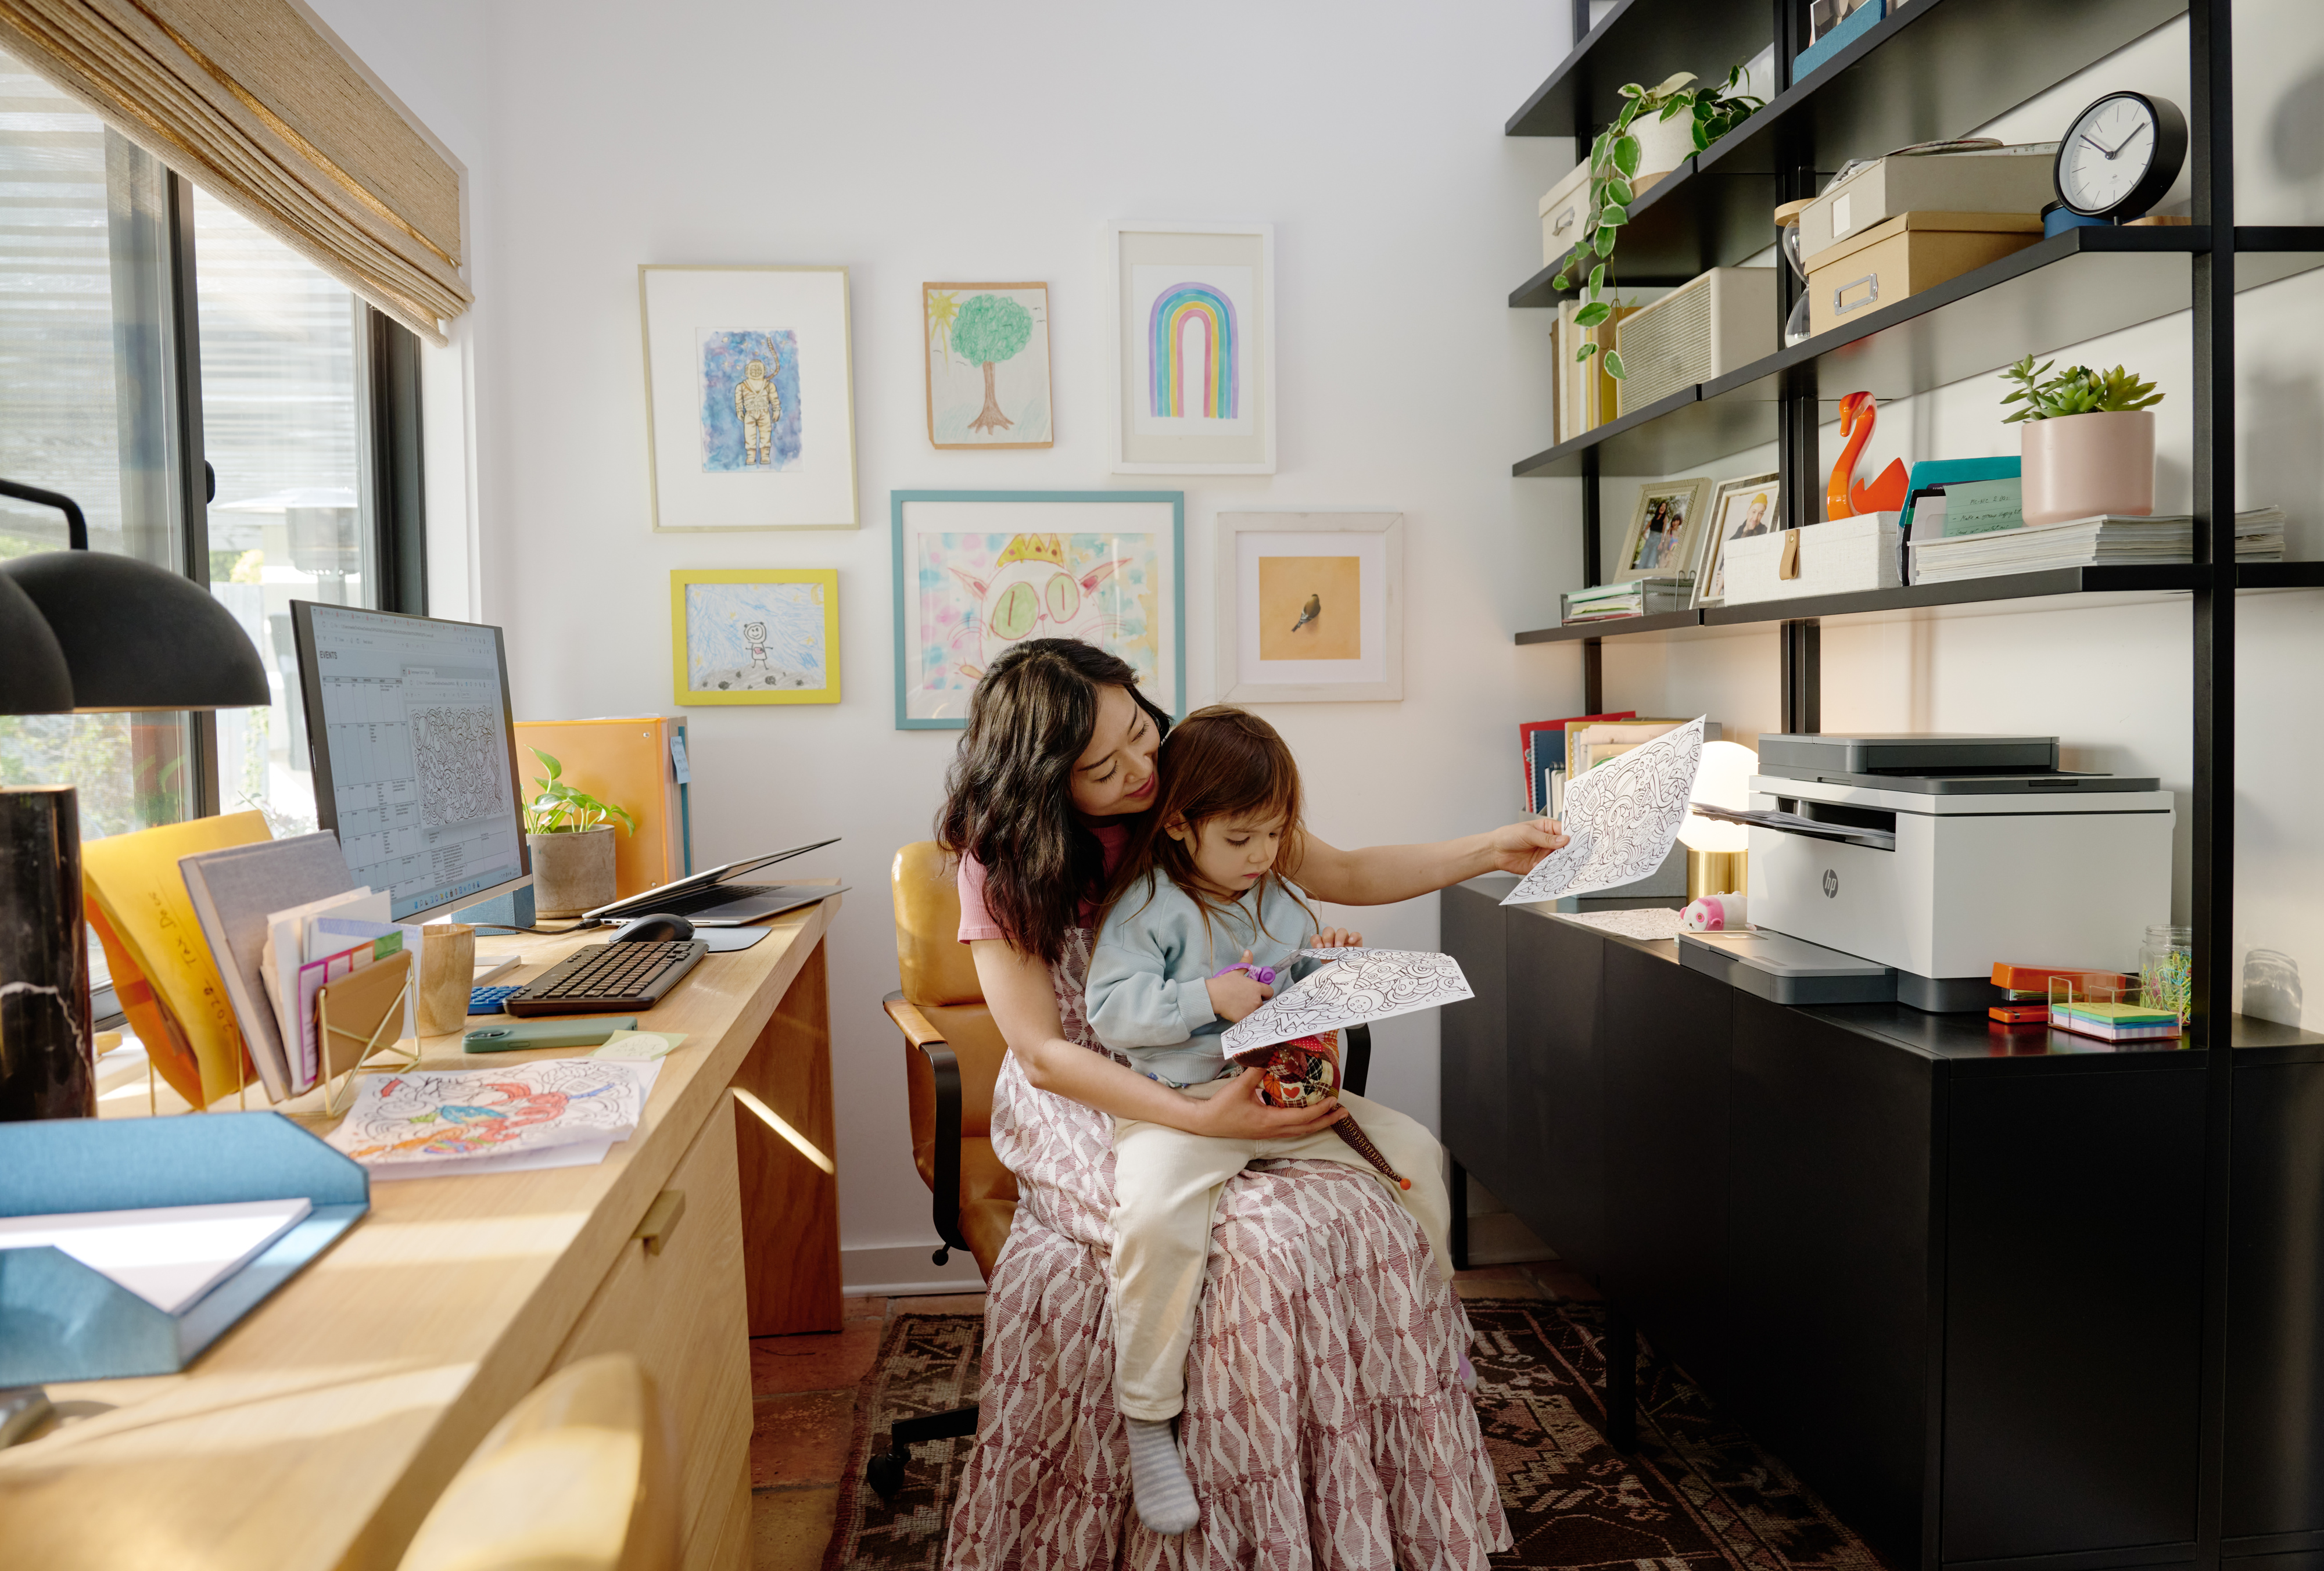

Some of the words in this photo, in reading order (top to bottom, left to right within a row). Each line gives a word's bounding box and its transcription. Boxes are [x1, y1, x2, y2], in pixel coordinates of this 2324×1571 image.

[320, 651, 338, 659] EVENTS
[1824, 869, 1837, 898] hp
[176, 937, 196, 969] Tax
